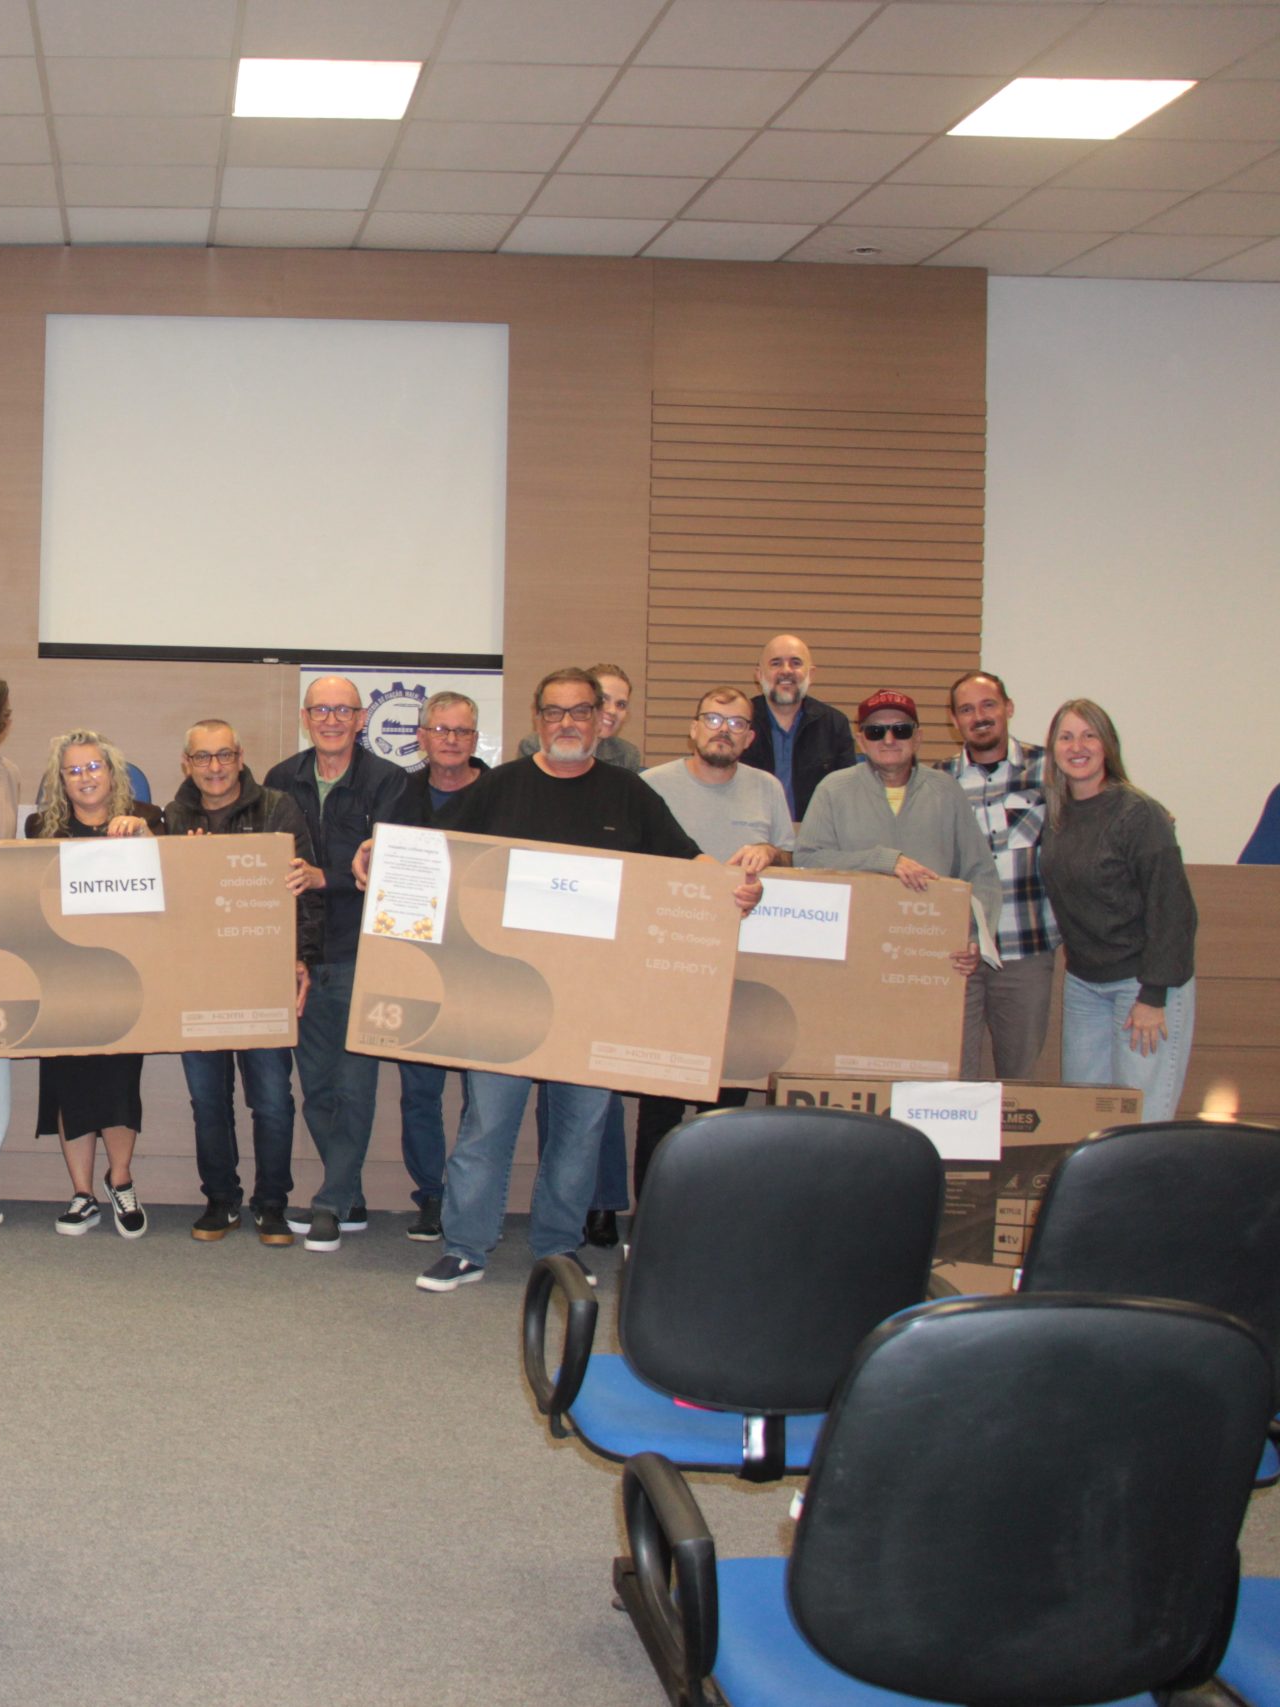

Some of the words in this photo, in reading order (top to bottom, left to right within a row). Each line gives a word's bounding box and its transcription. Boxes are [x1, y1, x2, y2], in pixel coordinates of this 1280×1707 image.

[226, 854, 268, 868] TCL
[69, 877, 156, 895] SINTRIVEST
[550, 877, 579, 893] SEC
[667, 880, 712, 900] TCL
[897, 901, 941, 917] TCL
[217, 927, 240, 937] LED
[242, 926, 265, 937] FHD
[265, 925, 282, 936] TV
[645, 957, 671, 970] LED
[673, 960, 698, 974] FHD
[699, 963, 718, 977] TV
[881, 972, 905, 984] LED
[907, 974, 931, 986] FHD
[933, 975, 951, 986] TV
[366, 1001, 404, 1031] 43
[906, 1107, 979, 1122] SETHOBRU
[1006, 1233, 1019, 1245] tv
